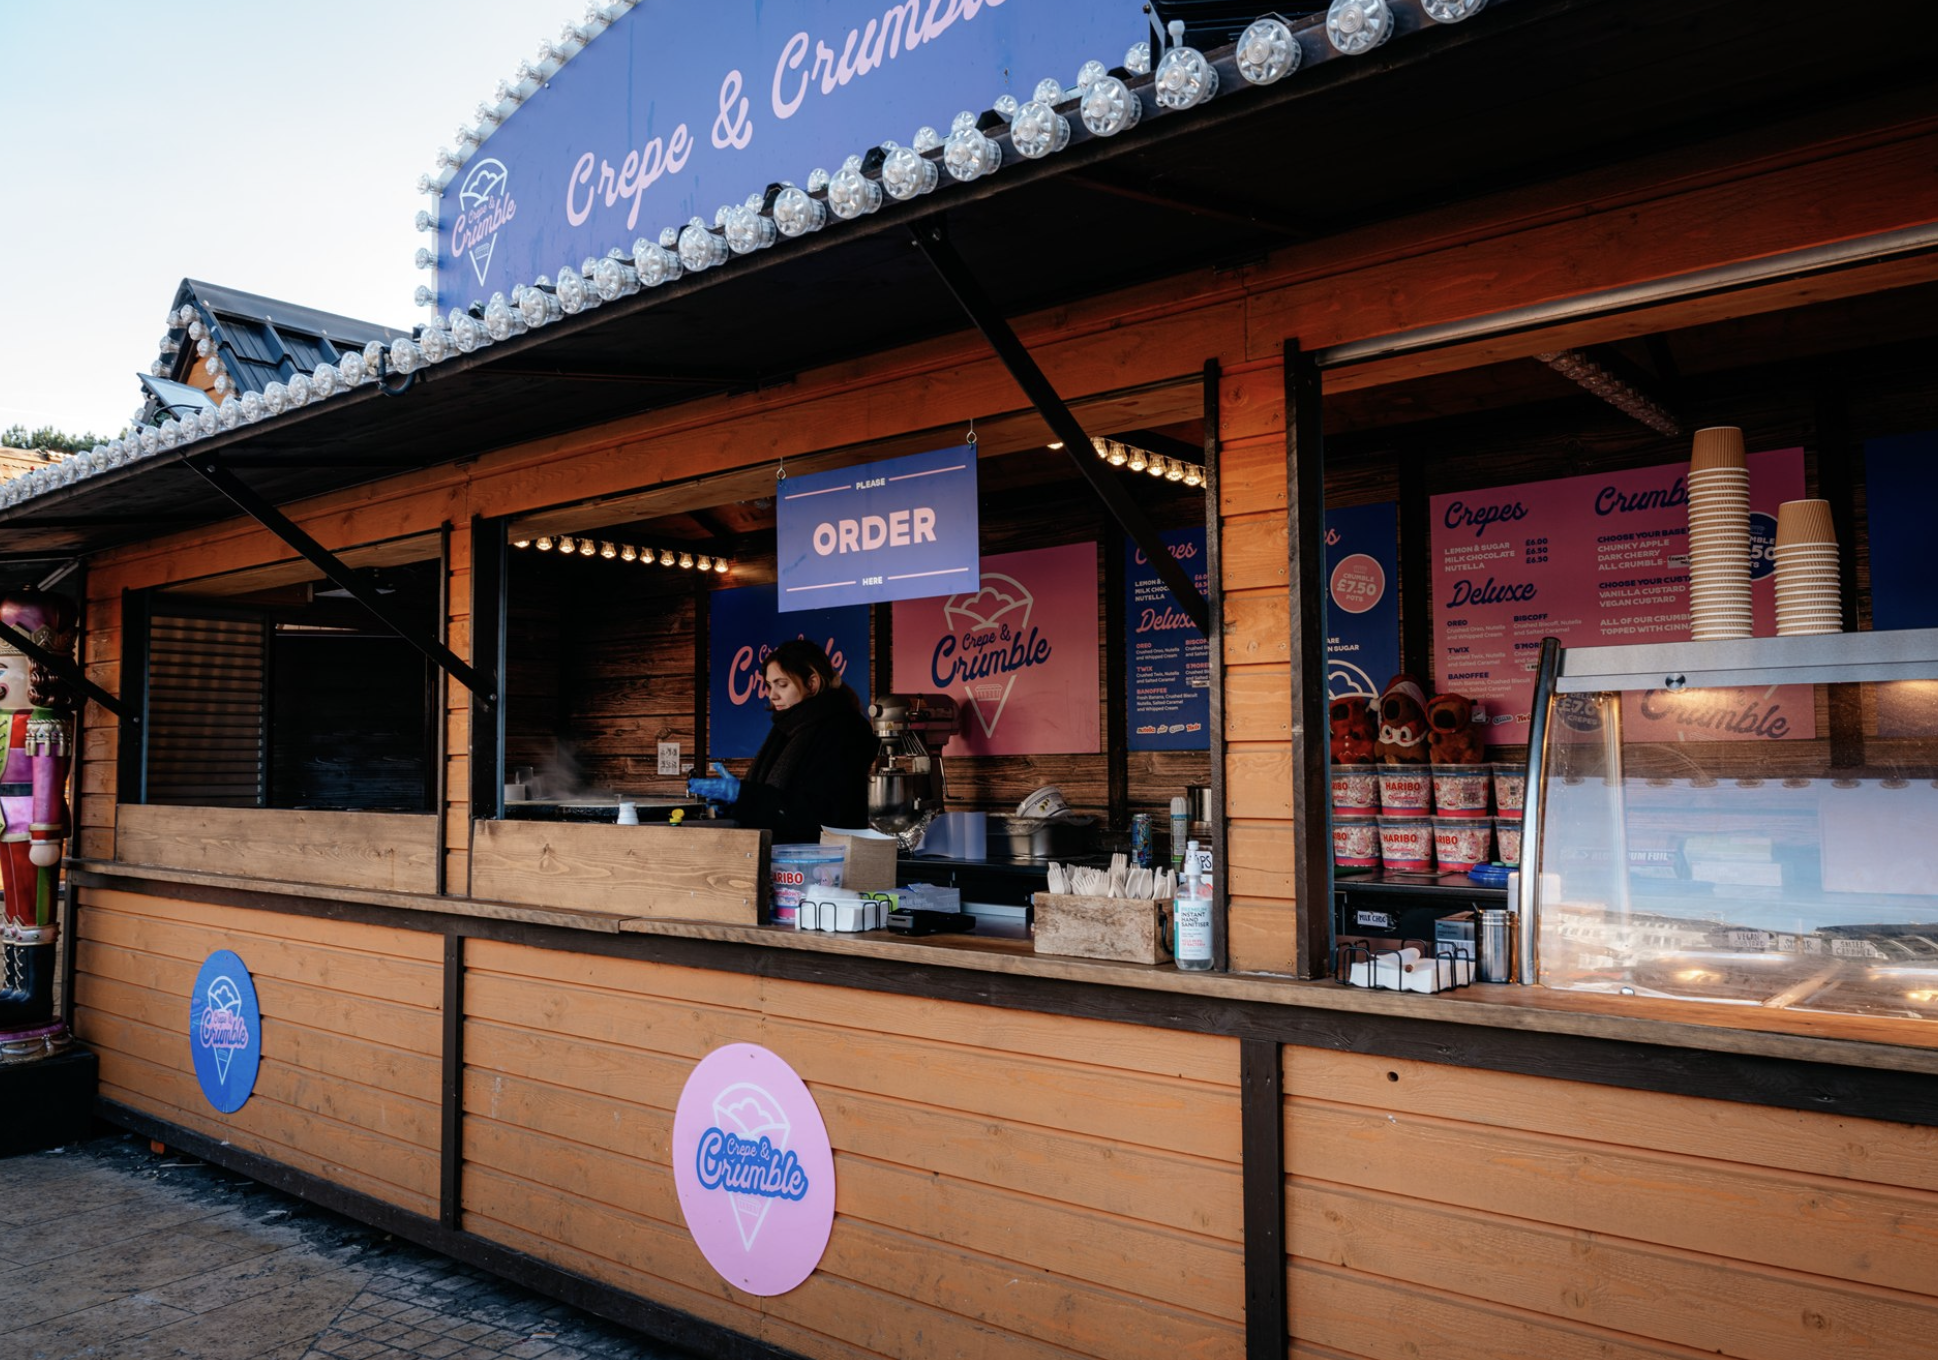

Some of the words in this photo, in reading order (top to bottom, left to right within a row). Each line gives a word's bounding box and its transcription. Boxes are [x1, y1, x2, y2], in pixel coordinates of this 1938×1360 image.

[566, 123, 694, 230] Crepe
[711, 69, 752, 150] &
[468, 205, 487, 224] Crepe
[451, 192, 516, 258] Crumble
[856, 478, 885, 490] PLEASE
[1595, 477, 1690, 516] Crumb
[1444, 501, 1529, 537] Crepes
[813, 507, 937, 556] ORDER
[1597, 533, 1635, 543] CHOOSE
[1636, 530, 1661, 540] YOUR
[1662, 527, 1686, 537] BASE
[1444, 546, 1473, 555] LEMON
[1481, 542, 1510, 551] SUGAR
[1525, 538, 1548, 546] £6.00
[1597, 542, 1640, 553] CHUNKY
[1640, 539, 1670, 549] APPLE
[1444, 556, 1466, 564] MILK
[1466, 551, 1515, 561] CHOCOLATE
[1525, 547, 1548, 555] £6.50
[1597, 552, 1624, 562] DARK
[1624, 549, 1661, 560] CHERRY
[1444, 562, 1485, 572] NUTELLA
[1525, 556, 1548, 564] £6.50
[1598, 562, 1617, 571] ALL
[862, 576, 883, 586] HERE
[1342, 572, 1375, 583] CRUMBLE
[1599, 579, 1636, 589] CHOOSE
[1636, 577, 1662, 586] YOUR
[1134, 580, 1156, 588] LEMON
[1336, 578, 1377, 596] £7.50
[1446, 577, 1538, 608] Deluxe
[1599, 588, 1641, 598] VANILLA
[1641, 585, 1686, 595] CUSTARD
[1135, 594, 1165, 602] NUTELLA
[1345, 594, 1364, 602] POTS
[1599, 598, 1632, 608] VEGAN
[1632, 595, 1676, 605] CUSTARD
[1447, 619, 1468, 627] OREO
[1513, 613, 1548, 622] BISCOFF
[1560, 618, 1582, 626] Nutella
[1600, 618, 1620, 626] ALL
[1620, 616, 1633, 625] OF
[1633, 615, 1653, 624] OUR
[1544, 626, 1570, 634] Caramel
[1600, 625, 1636, 635] TOPPED
[1637, 624, 1663, 633] WITH
[962, 632, 996, 653] Crepe
[1000, 623, 1011, 641] &
[1333, 644, 1359, 652] SUGAR
[1447, 646, 1470, 654] TWIX
[931, 626, 1052, 688] Crumble
[1447, 672, 1489, 680] BANOFFEE
[1517, 714, 1531, 722] Twi
[1567, 714, 1598, 725] CREPES
[1385, 782, 1421, 791] HARIBO
[1383, 834, 1417, 843] HARIBO
[1647, 852, 1668, 861] FOIL
[1358, 914, 1371, 922] MILK
[1371, 914, 1387, 923] CHOC
[1736, 933, 1762, 941] VEGAN
[201, 1008, 247, 1047] Crumble
[727, 1138, 757, 1162] Crepe
[760, 1142, 770, 1160] &
[697, 1130, 807, 1198] Crumble
